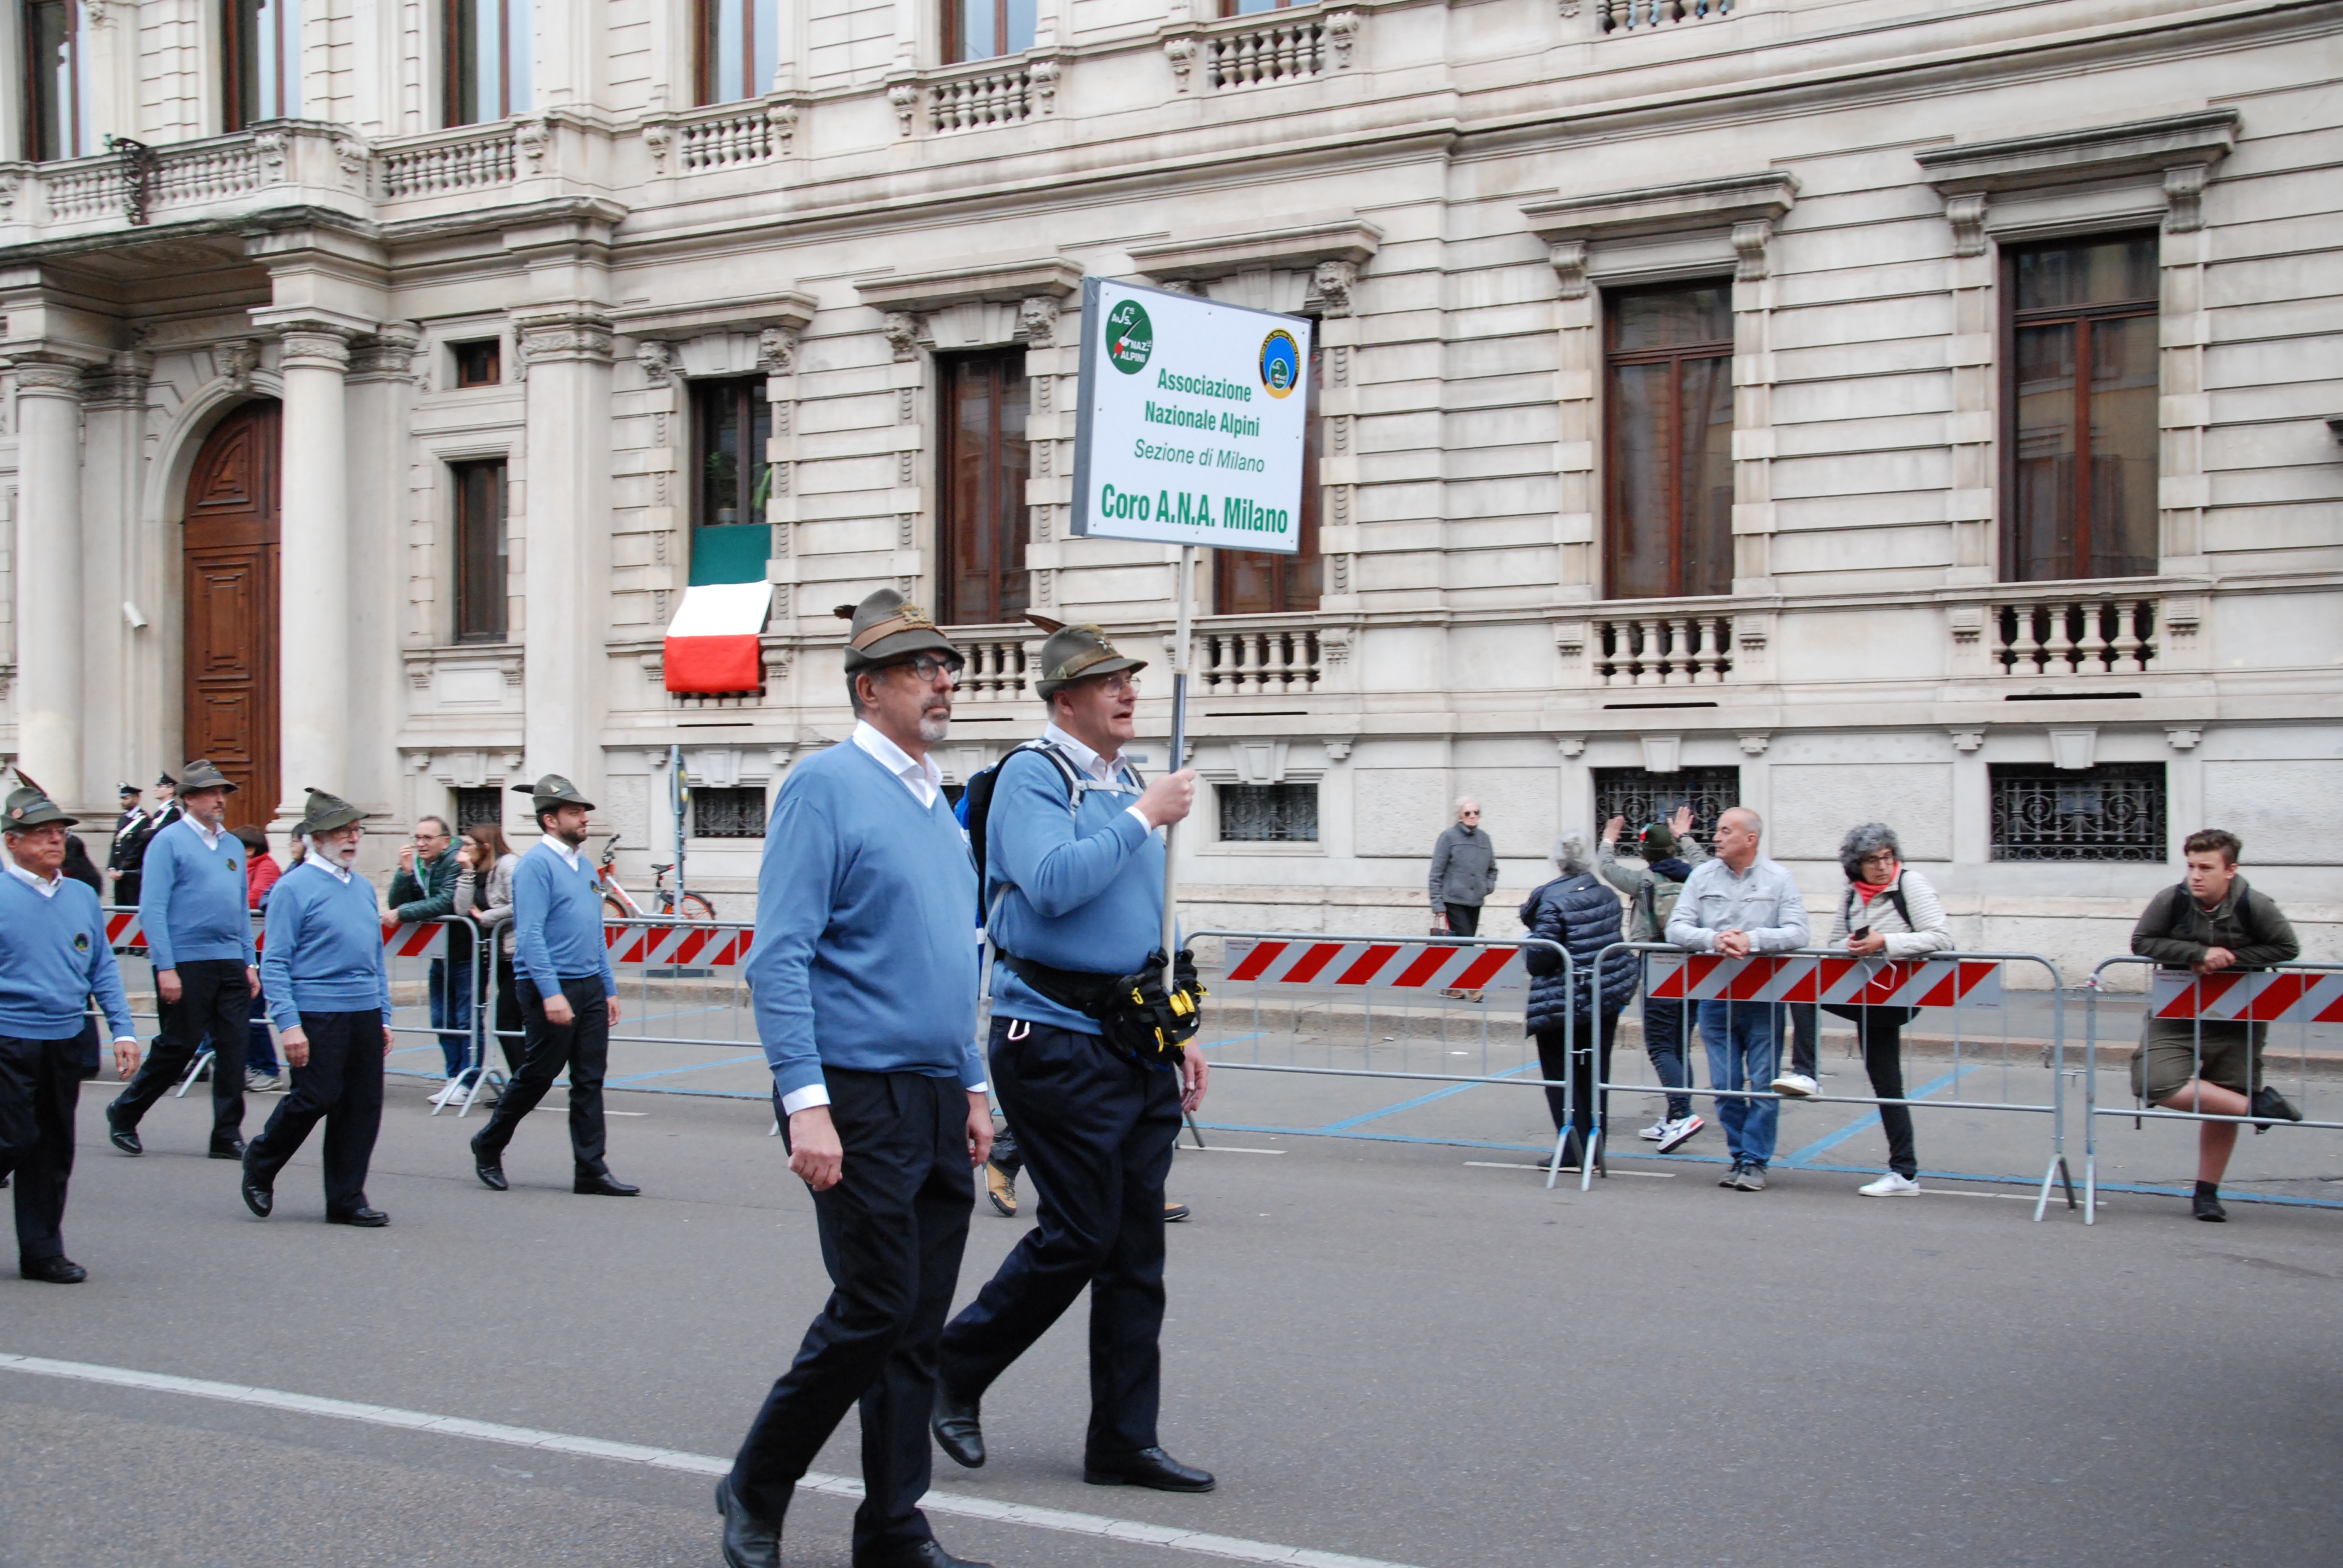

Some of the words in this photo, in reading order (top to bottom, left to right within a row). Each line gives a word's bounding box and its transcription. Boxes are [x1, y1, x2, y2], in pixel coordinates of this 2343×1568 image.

[1120, 350, 1145, 363] ALPINI
[1158, 368, 1251, 402] Associazione
[1145, 400, 1216, 431] Nazionale
[1220, 412, 1260, 438] Alpini
[1135, 439, 1194, 464] Sezione
[1199, 448, 1213, 466] di
[1217, 449, 1265, 473] Milano
[1101, 483, 1150, 521] Coro
[1155, 490, 1216, 527] A.N.A.
[1223, 497, 1288, 534] Milano
